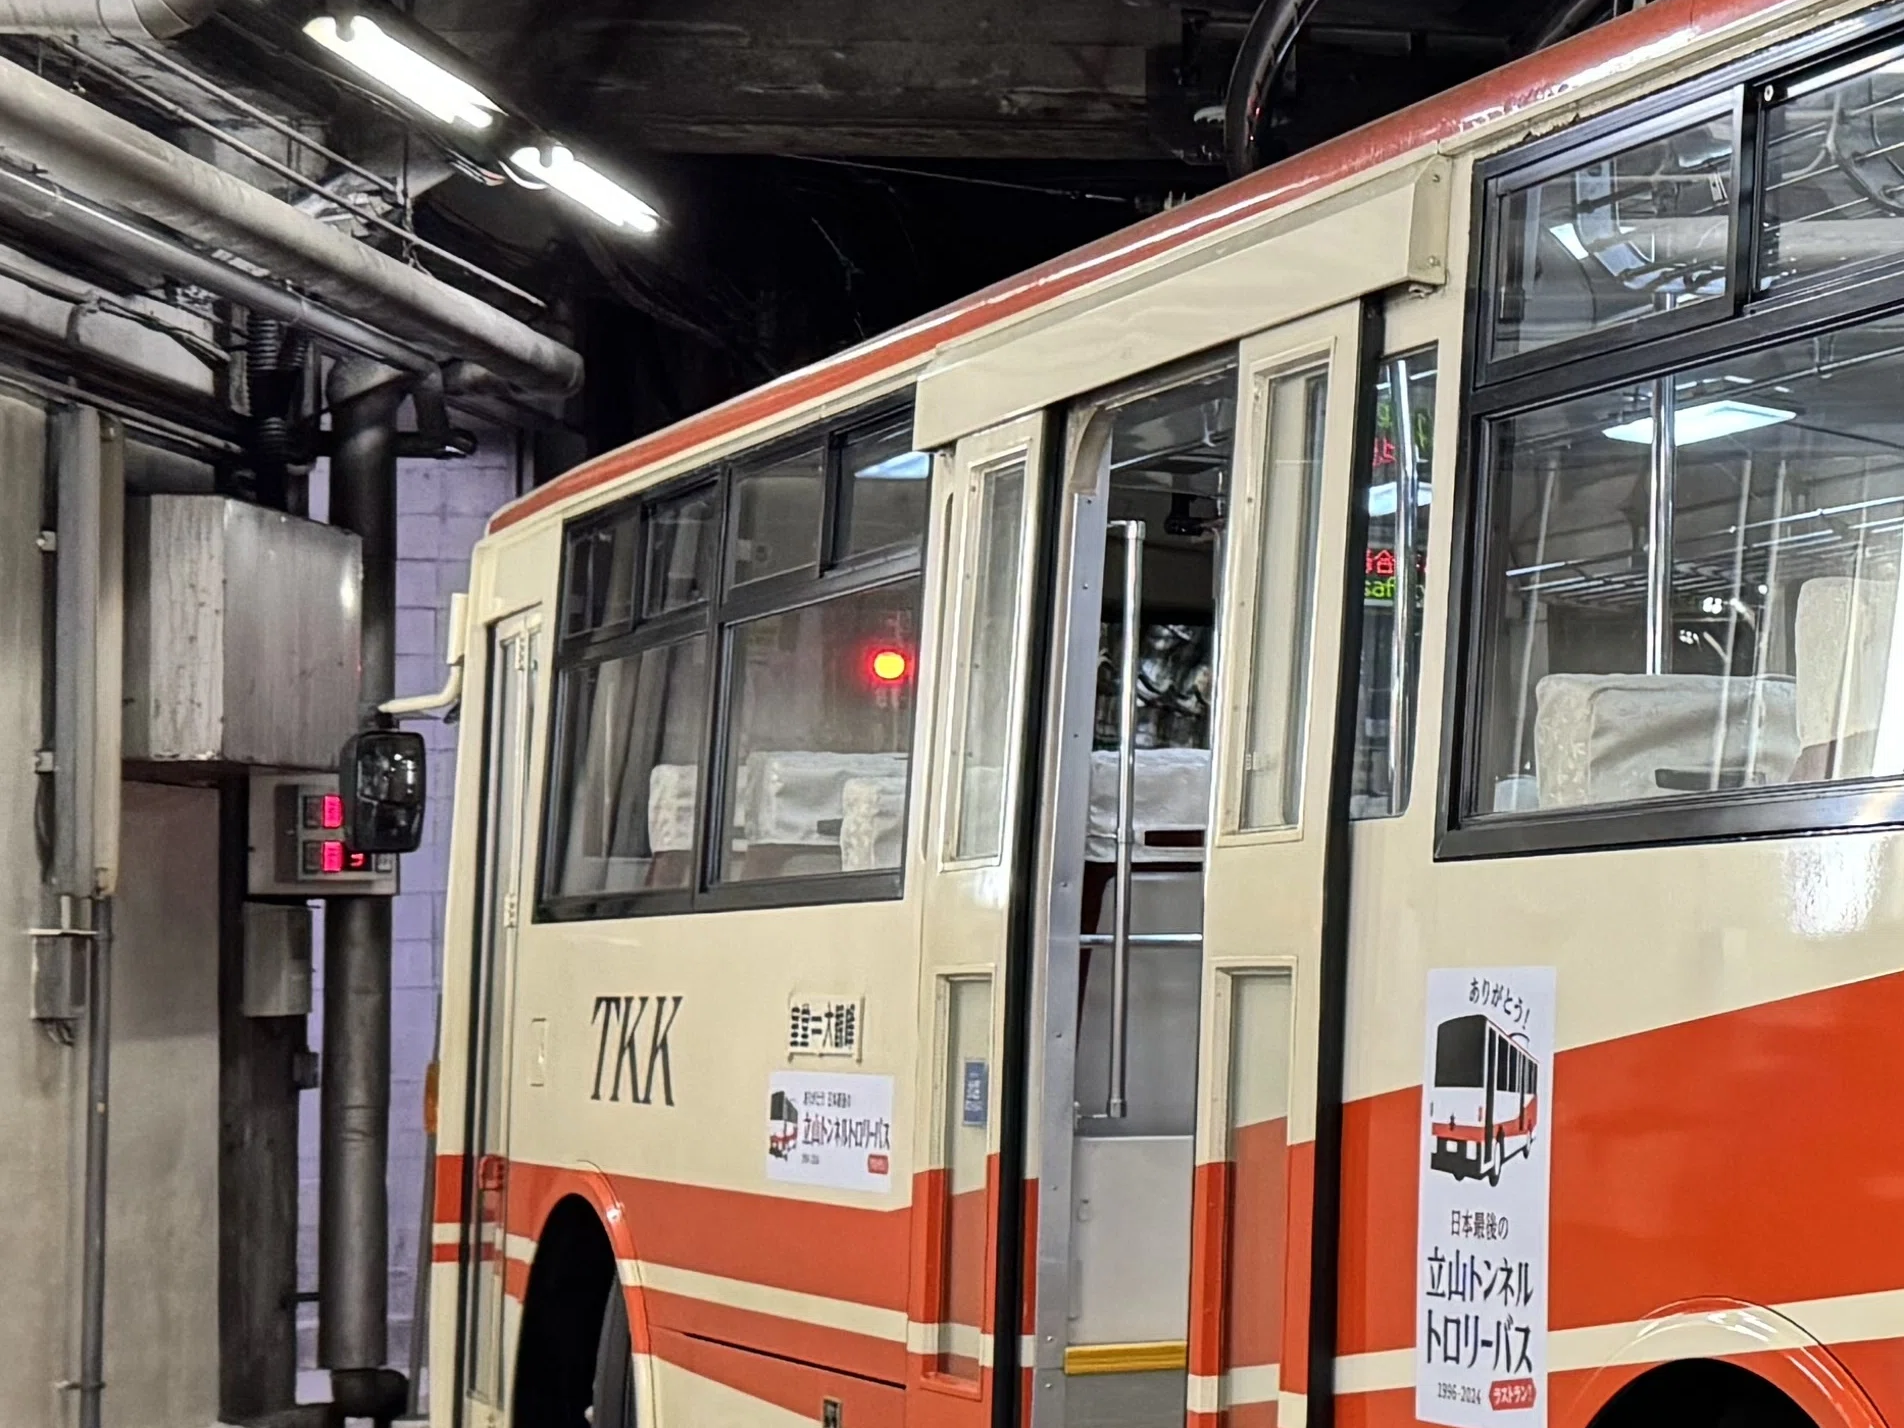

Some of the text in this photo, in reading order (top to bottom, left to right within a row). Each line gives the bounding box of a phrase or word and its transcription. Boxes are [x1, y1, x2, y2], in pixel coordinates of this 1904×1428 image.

[590, 995, 684, 1107] TKK
[1450, 1208, 1509, 1241] 日本最後の
[1425, 1245, 1534, 1308] 立山トンネル
[1426, 1308, 1533, 1375] トロリーバス
